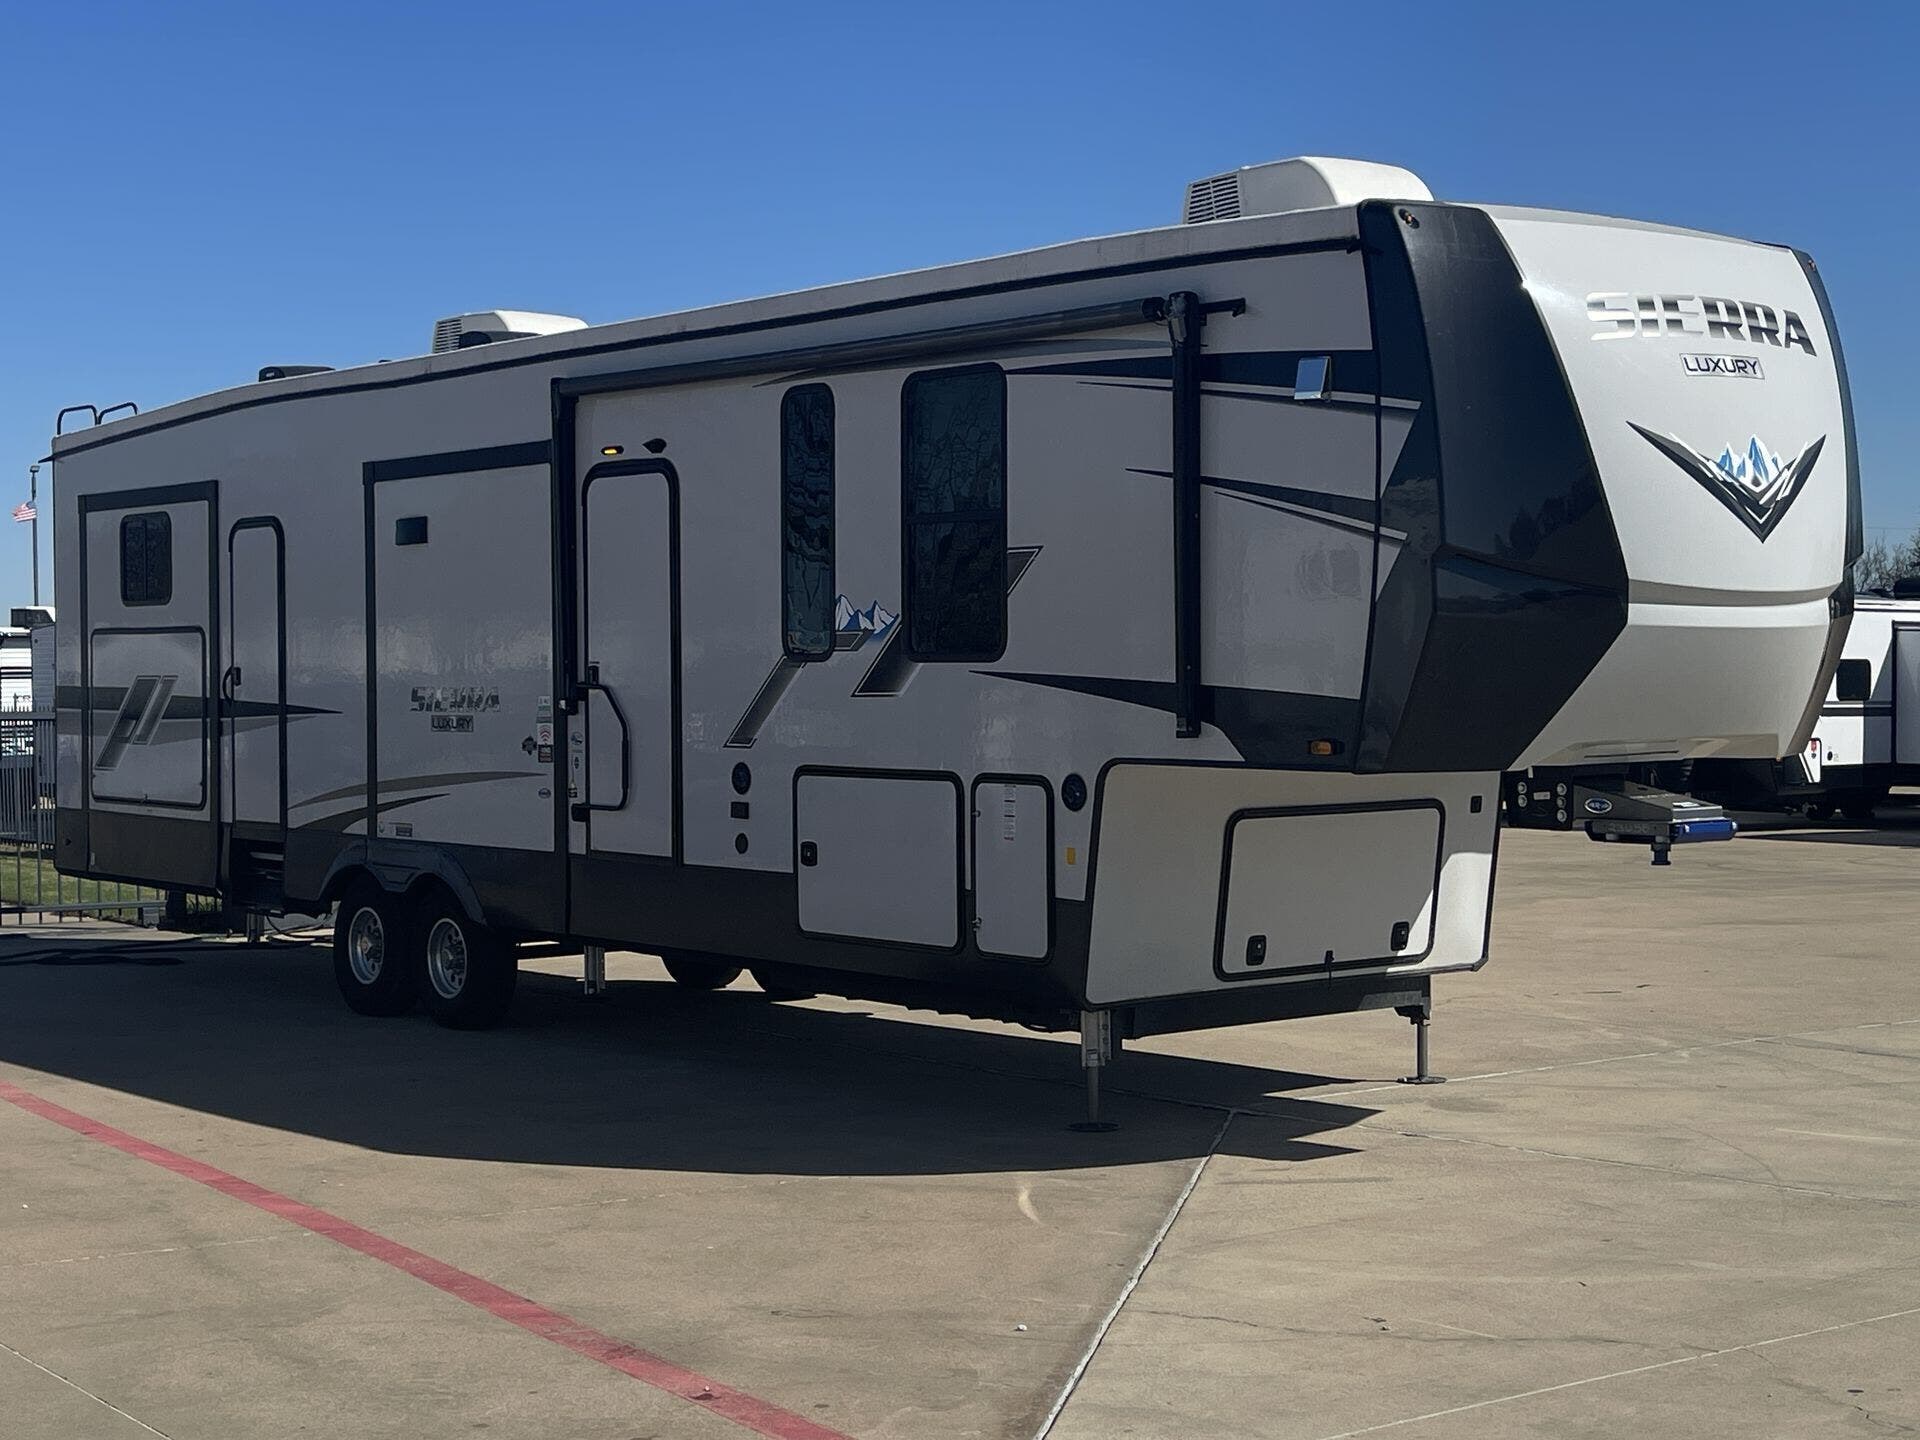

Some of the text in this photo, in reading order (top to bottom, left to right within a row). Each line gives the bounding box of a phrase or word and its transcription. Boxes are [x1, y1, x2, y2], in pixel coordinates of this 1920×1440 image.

[1586, 292, 1817, 357] SIERRA
[1683, 357, 1759, 375] LUXURY
[410, 686, 500, 712] SIERRA
[431, 717, 472, 729] LUXURY
